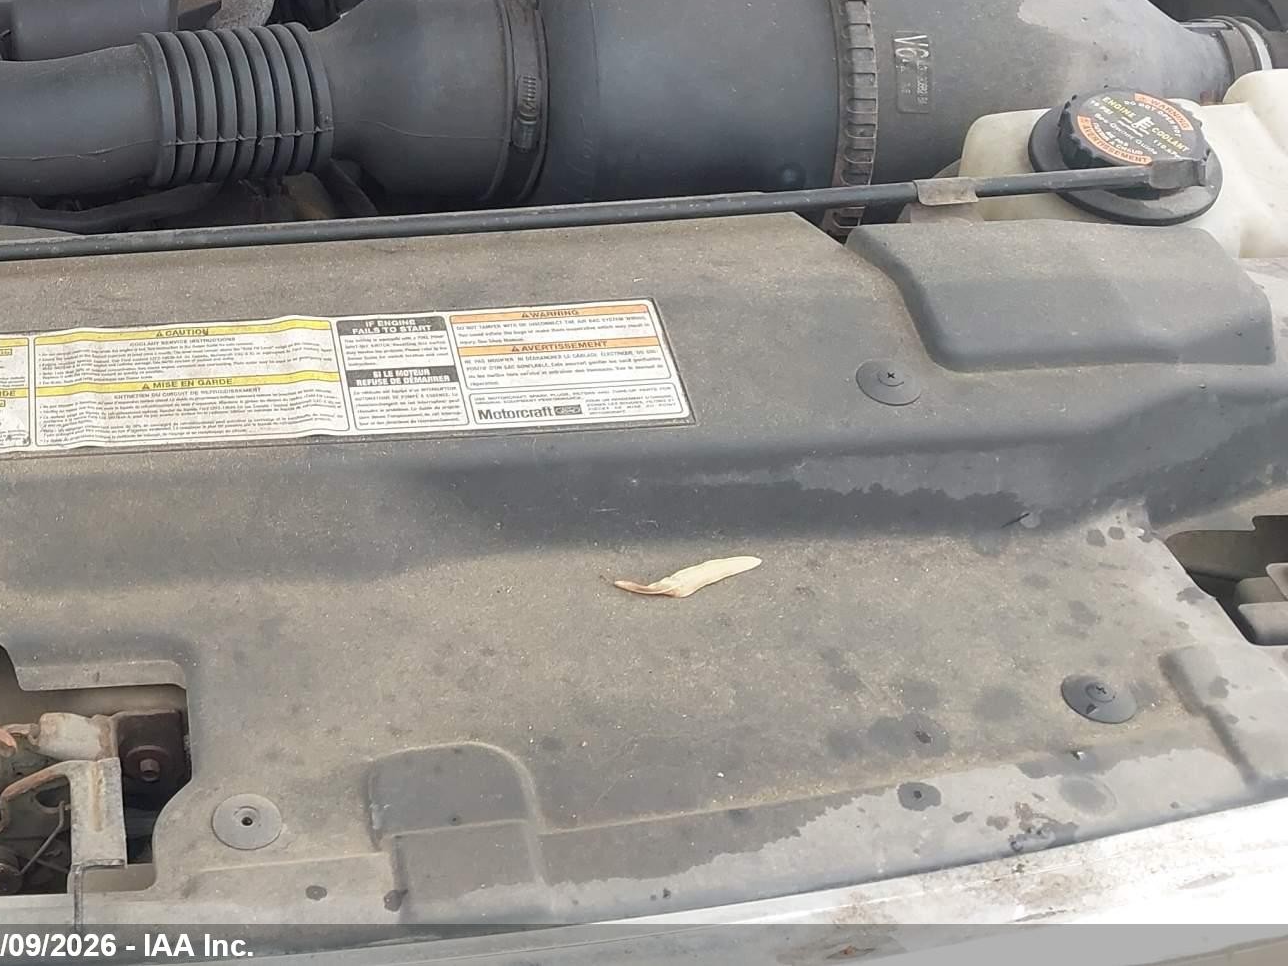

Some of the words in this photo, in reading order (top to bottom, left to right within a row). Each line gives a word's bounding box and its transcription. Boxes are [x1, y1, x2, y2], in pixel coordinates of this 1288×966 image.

[1102, 96, 1136, 116] ENGINE
[1152, 127, 1190, 152] COOLANT
[531, 309, 578, 318] WARNING
[377, 319, 416, 327] ENGINE
[165, 328, 210, 337] CAUTION
[521, 340, 608, 352] AVERTISSEMENT
[181, 379, 194, 387] EN
[198, 378, 232, 386] GARDE
[478, 406, 554, 420] Motorcraft
